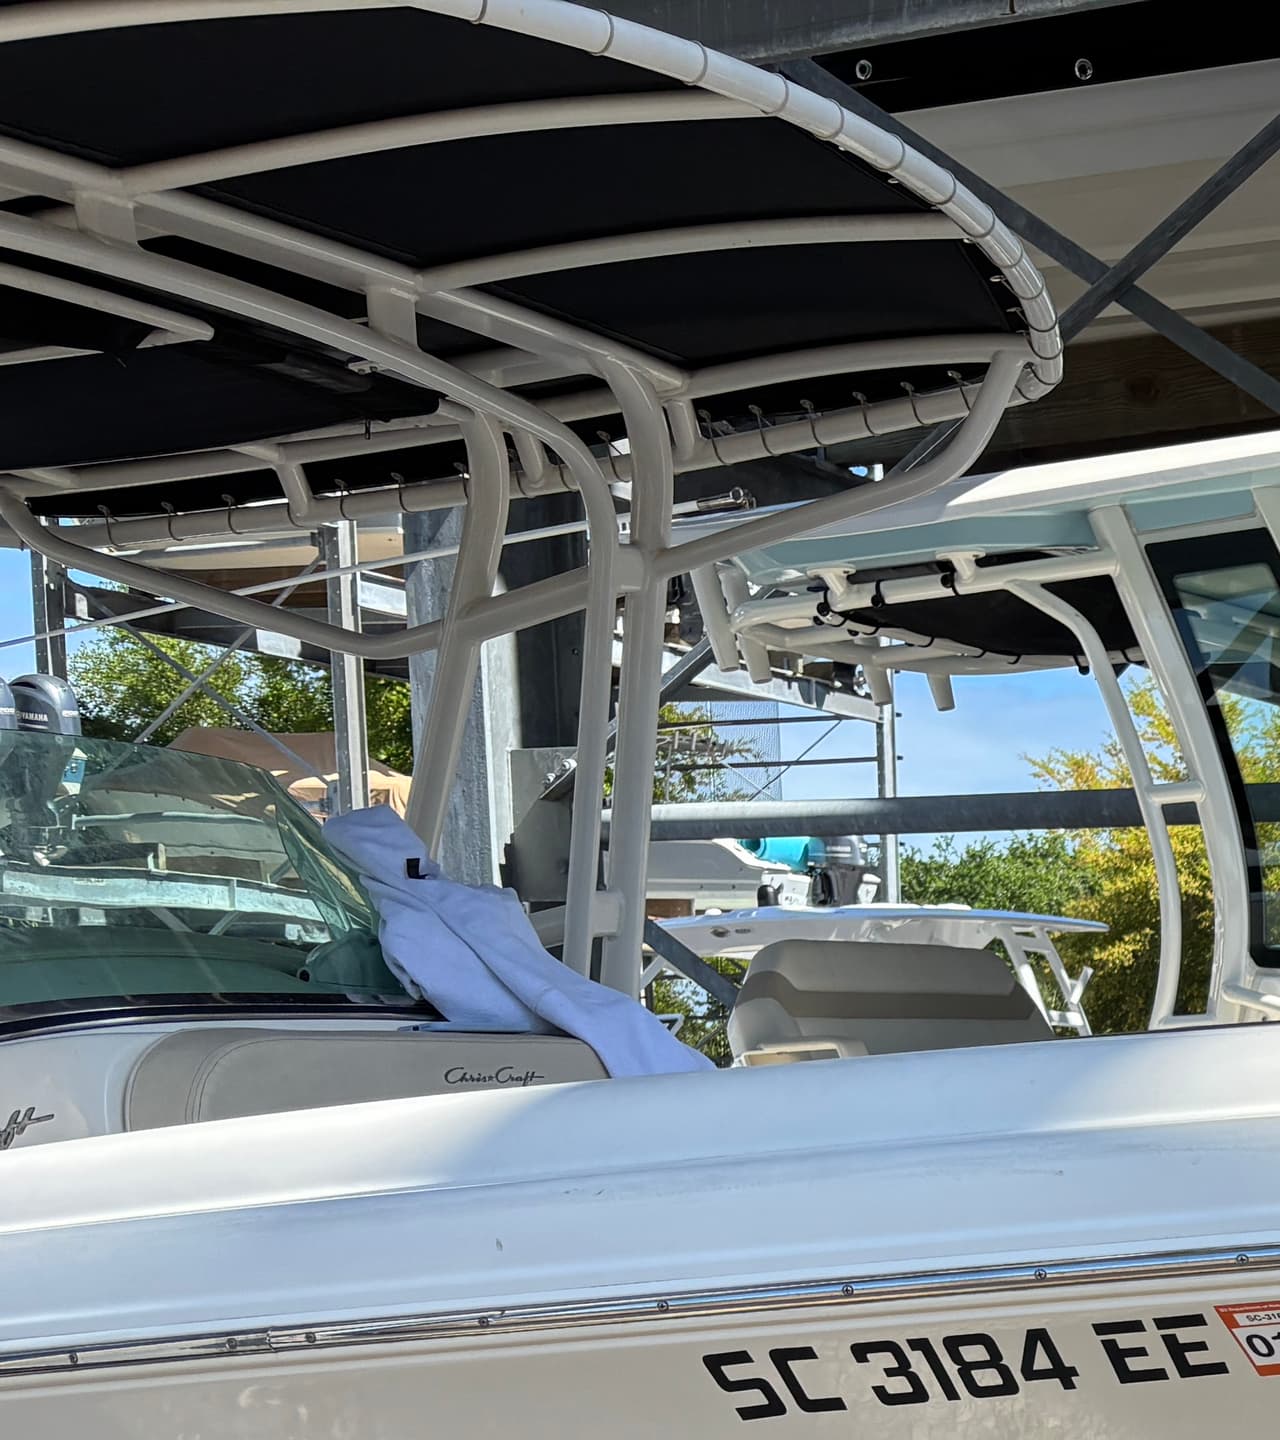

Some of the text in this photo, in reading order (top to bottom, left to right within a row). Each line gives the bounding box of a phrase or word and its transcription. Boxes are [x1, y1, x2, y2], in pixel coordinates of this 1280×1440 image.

[22, 711, 49, 721] YAMAHA
[702, 1313, 1230, 1422] SC 3184 EE
